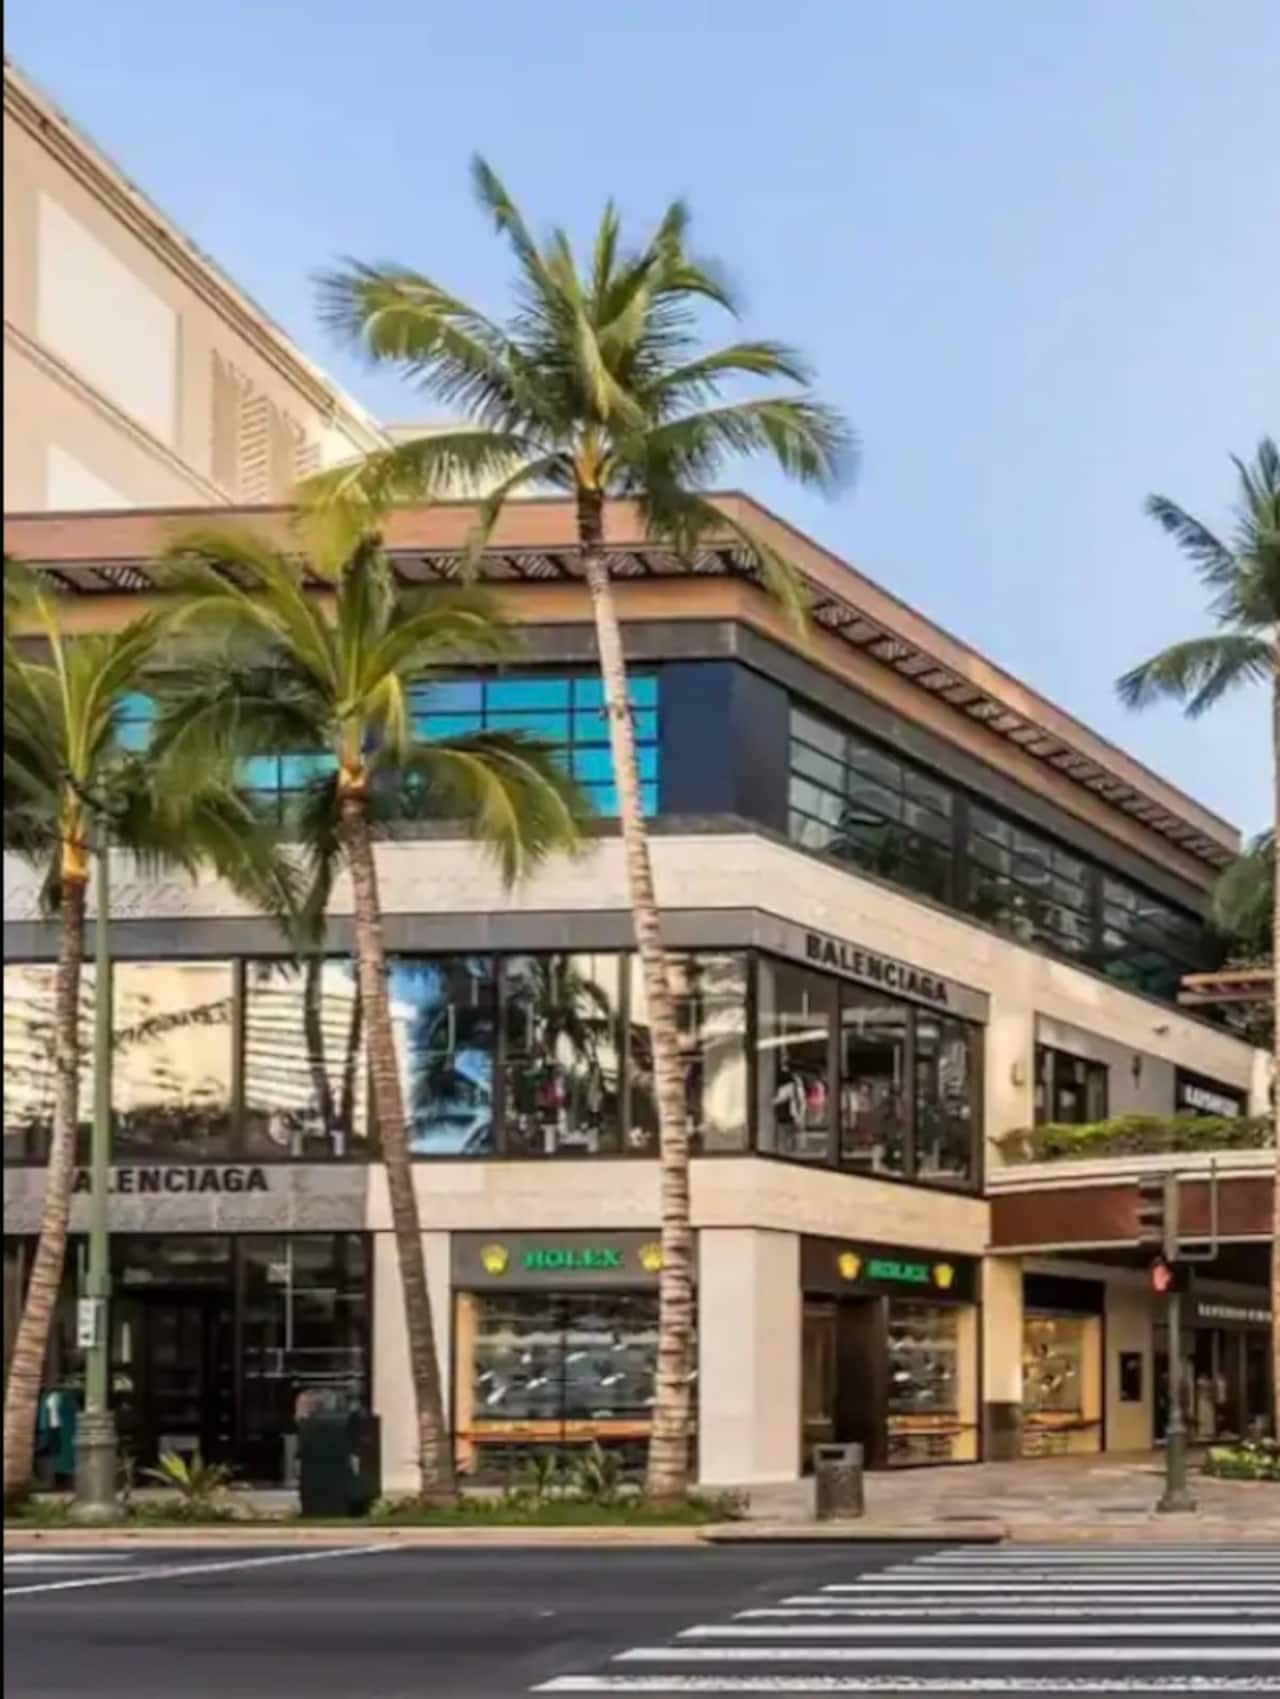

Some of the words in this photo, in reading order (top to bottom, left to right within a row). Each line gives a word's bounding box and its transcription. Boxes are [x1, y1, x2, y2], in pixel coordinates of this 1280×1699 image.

[805, 933, 948, 1003] BALENCIAGA
[71, 1168, 268, 1193] AENCIAGA
[522, 1249, 622, 1271] ROLEX
